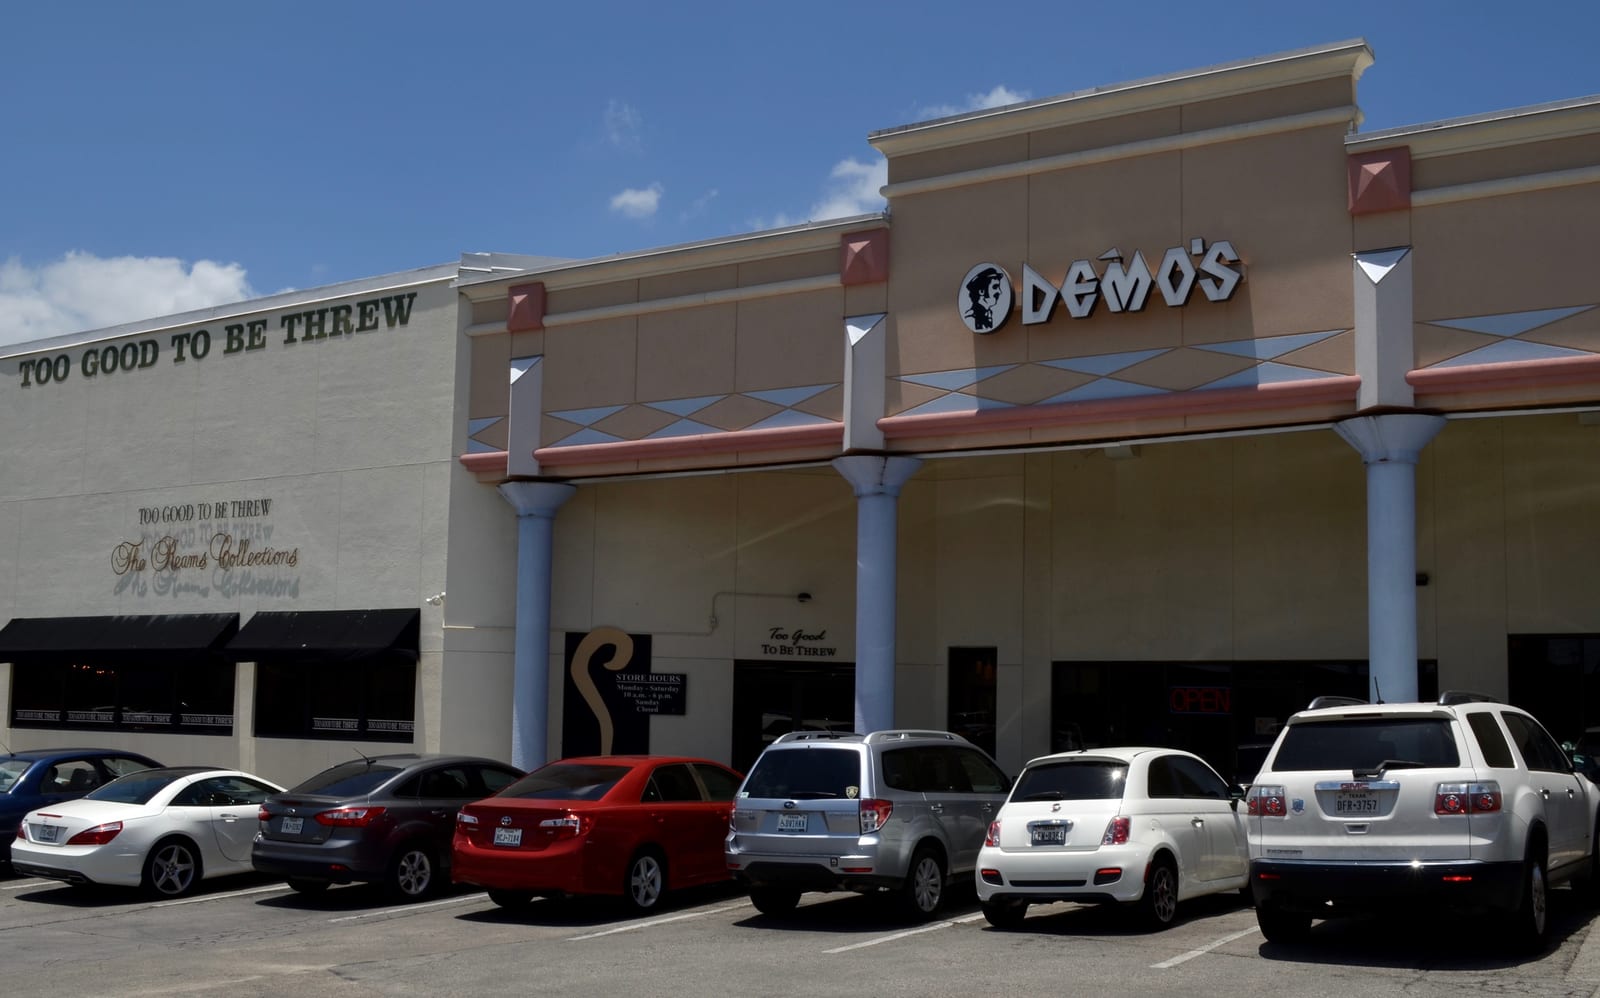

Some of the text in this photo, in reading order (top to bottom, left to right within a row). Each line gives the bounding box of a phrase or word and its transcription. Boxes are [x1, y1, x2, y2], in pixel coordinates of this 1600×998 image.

[19, 292, 417, 387] TOO GOOD TO BE THREW
[139, 498, 272, 525] TOO GOOD TO BE THREW
[111, 537, 146, 575] The
[210, 532, 298, 569] Collections
[769, 627, 826, 645] Too Good
[616, 673, 681, 682] STORE HOURS
[616, 684, 643, 692] Monday
[649, 685, 679, 693] Saturday
[1170, 687, 1233, 713] OPEN
[1341, 783, 1370, 791] GMC
